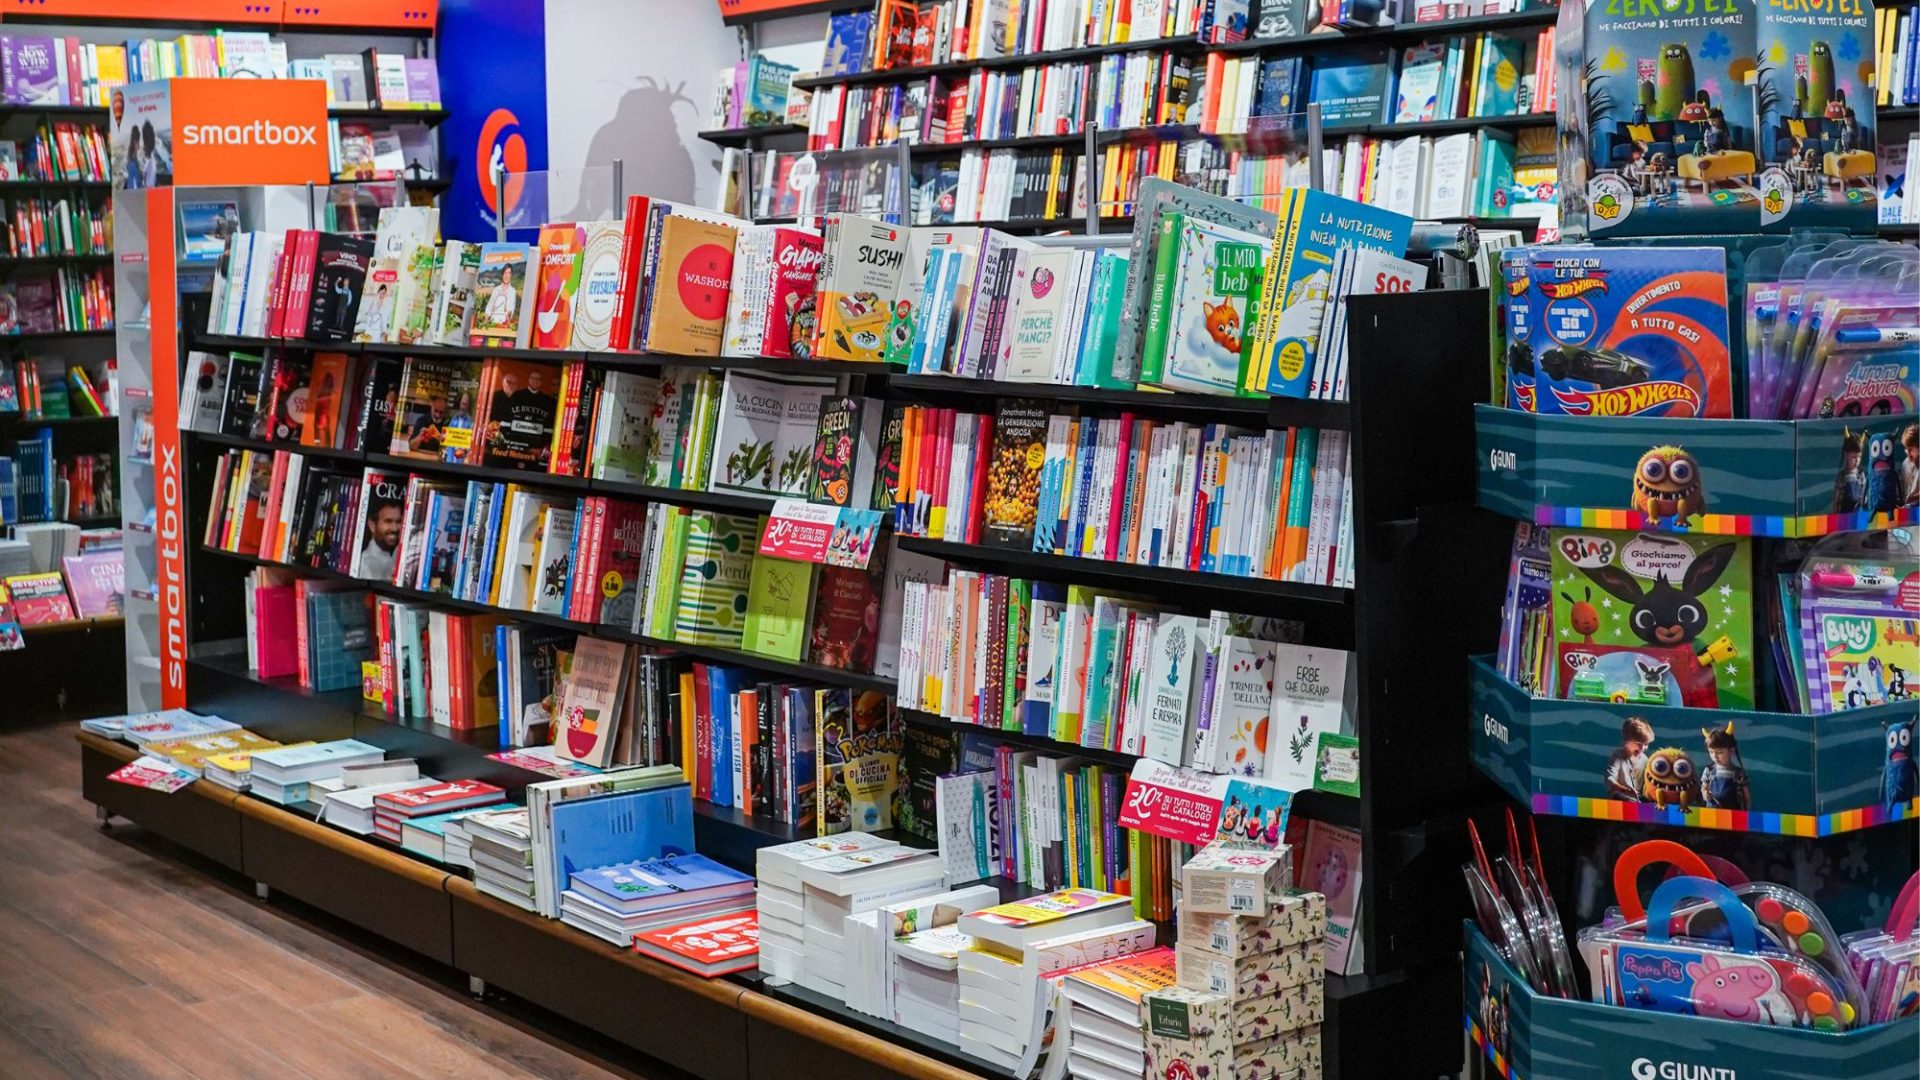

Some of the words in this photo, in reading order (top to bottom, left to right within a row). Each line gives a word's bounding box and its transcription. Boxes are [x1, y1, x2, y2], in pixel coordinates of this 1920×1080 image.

[1599, 24, 1610, 32] NE
[1613, 21, 1657, 31] FACCIAMO
[1659, 20, 1669, 29] DI
[1672, 18, 1700, 28] TUTTI
[1702, 18, 1708, 26] I
[1710, 13, 1743, 25] COLORI!
[1776, 14, 1808, 24] FACCIAMO
[1809, 16, 1816, 25] DI
[1817, 16, 1837, 26] TUTTI
[1844, 17, 1868, 27] COLORI!
[183, 120, 317, 145] smartbox
[1319, 211, 1333, 226] LA
[1337, 215, 1393, 242] NUTRIZIONE
[1310, 229, 1337, 248] INIZIA
[857, 244, 903, 271] SUSHI
[1222, 247, 1233, 268] IL
[1234, 248, 1256, 269] MIO
[1281, 232, 1296, 276] NUTRIZIONE
[1555, 258, 1581, 269] GIOCA
[1583, 258, 1600, 269] CON
[1221, 269, 1249, 291] beb
[1375, 271, 1412, 294] SOS
[1555, 269, 1566, 278] LE
[1570, 269, 1585, 278] TUE
[1154, 282, 1164, 302] MIO
[1276, 278, 1286, 299] INIZIA
[1626, 281, 1681, 314] DIVERTIMENTO
[1021, 312, 1053, 330] PERCHÉ
[1150, 302, 1161, 333] bebè
[1561, 317, 1580, 329] 50
[1017, 330, 1052, 345] PIANGI?
[1630, 318, 1639, 330] A
[1642, 317, 1675, 332] TUTTO
[1677, 324, 1701, 344] GAS!
[1850, 362, 1899, 381] Aurora
[1846, 378, 1900, 399] Ludovica
[736, 393, 750, 405] LA
[751, 395, 784, 411] CUCIN
[788, 401, 798, 412] LA
[1590, 393, 1627, 416] HOT
[1626, 383, 1692, 413] WHEELS
[822, 410, 850, 432] GREEN
[1001, 407, 1026, 418] Jonathan
[1005, 418, 1045, 429] GENERAZIONE
[1006, 427, 1032, 437] ANSIOSA
[1497, 449, 1516, 470] GIUNTI
[1126, 462, 1135, 494] GENITORI
[1133, 472, 1142, 504] GENITORI
[1121, 503, 1130, 533] DIVENTA
[1130, 504, 1139, 532] GENTILI
[799, 533, 826, 543] CATALOGO
[1562, 537, 1612, 564] Bing
[1631, 549, 1687, 560] Giochiamo
[161, 444, 183, 690] smartbox
[1635, 560, 1646, 568] al
[1649, 560, 1682, 570] parco!
[990, 640, 1000, 689] YOGA
[1567, 653, 1597, 670] Bing
[1296, 665, 1320, 683] ERBE
[1285, 681, 1299, 694] CHE
[1300, 682, 1330, 696] CURANO
[1157, 694, 1182, 712] FERMATI
[757, 700, 767, 730] Sud
[1152, 708, 1159, 720] E
[1159, 710, 1182, 726] RESPIRA
[1490, 717, 1509, 745] GIUNTI
[733, 731, 741, 753] EASY
[734, 754, 742, 773] FISH
[850, 769, 858, 779] DI
[860, 764, 892, 777] CUCINA
[855, 774, 887, 785] UFFICIALE
[1162, 803, 1169, 811] DI
[1173, 805, 1212, 822] CATALOGO
[1164, 794, 1172, 804] SU
[1173, 796, 1191, 808] TUTTI
[1195, 802, 1214, 814] TITOLI
[1626, 956, 1661, 976] Peppa
[1662, 958, 1681, 979] Pig
[1660, 1060, 1736, 1080] GIUNTI
